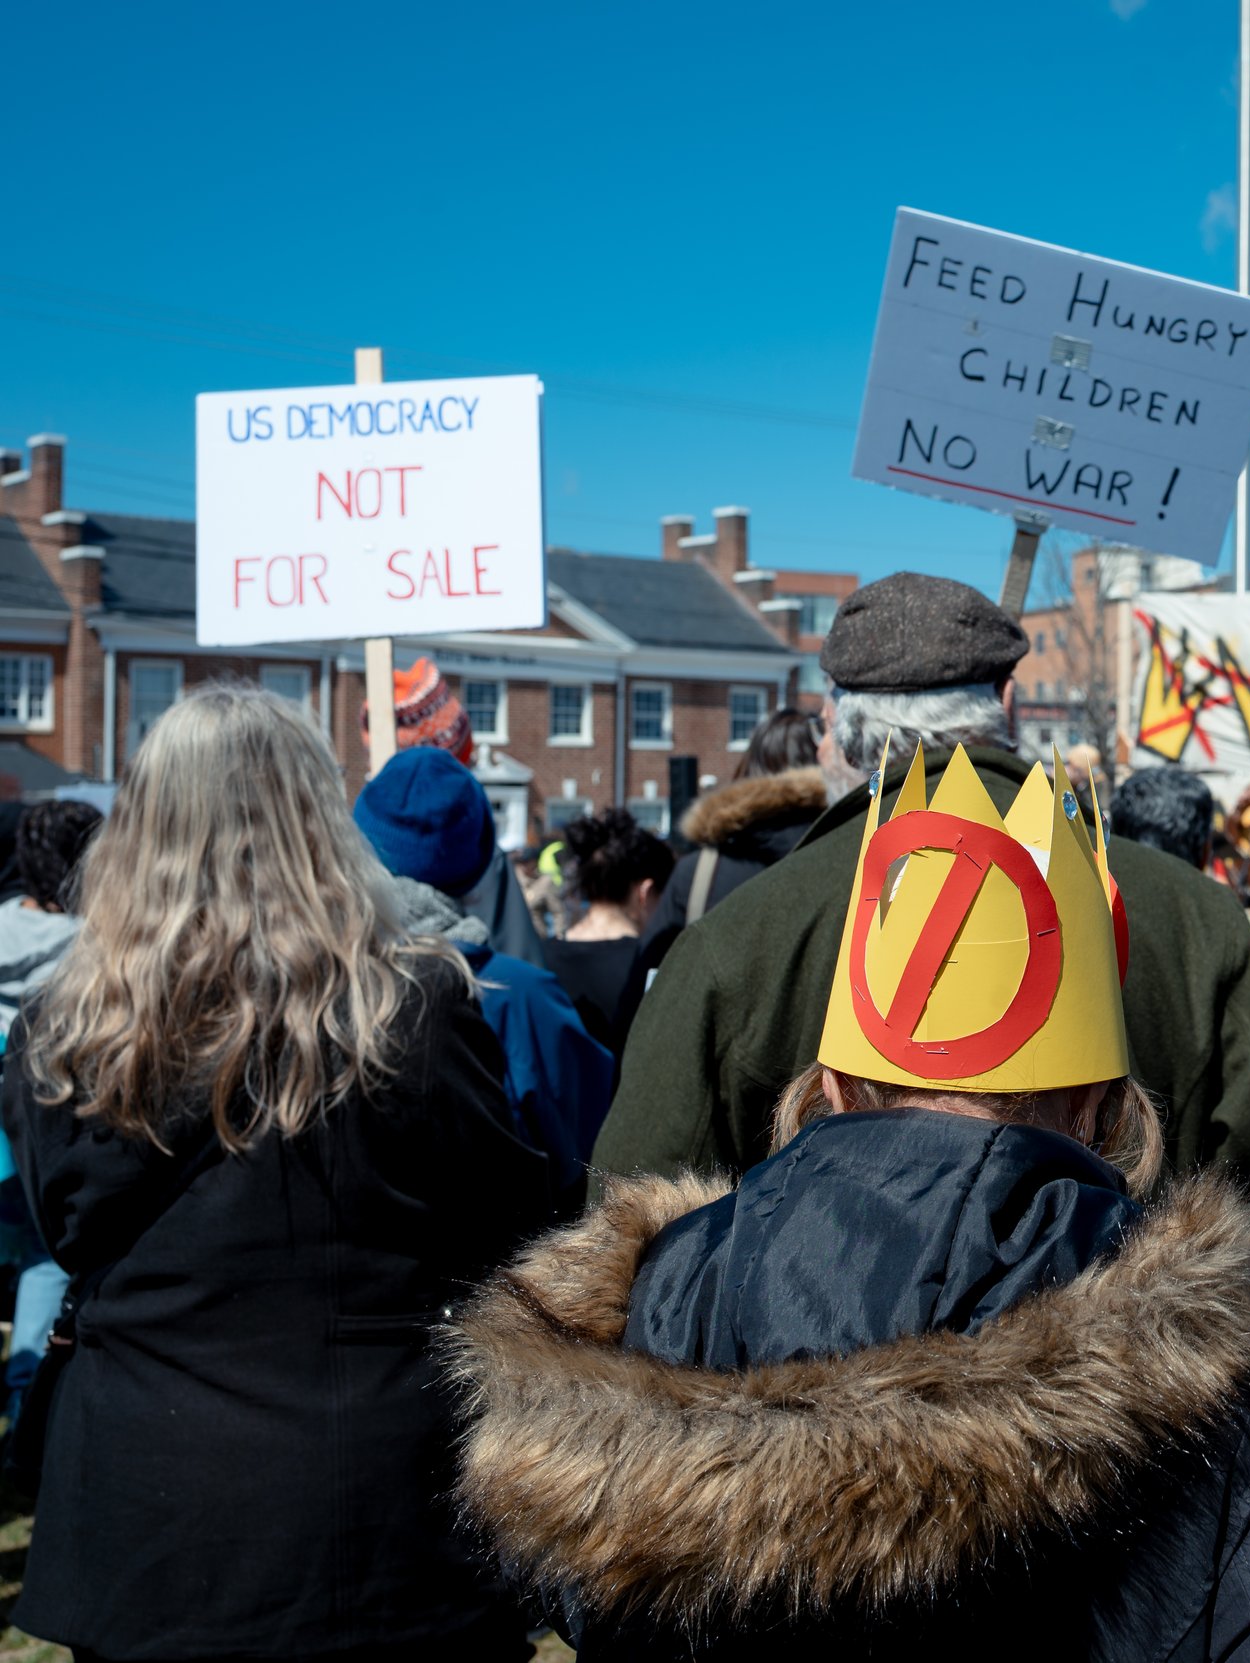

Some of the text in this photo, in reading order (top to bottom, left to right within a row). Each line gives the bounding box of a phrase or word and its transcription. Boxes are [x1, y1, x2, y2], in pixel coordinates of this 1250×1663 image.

[903, 236, 1027, 305] FEED
[959, 348, 1201, 427] CHILDREN
[227, 396, 479, 443] US DEMOCRACY
[898, 418, 978, 471] NO
[316, 465, 423, 521] NOT
[233, 544, 502, 609] FOR SALE
